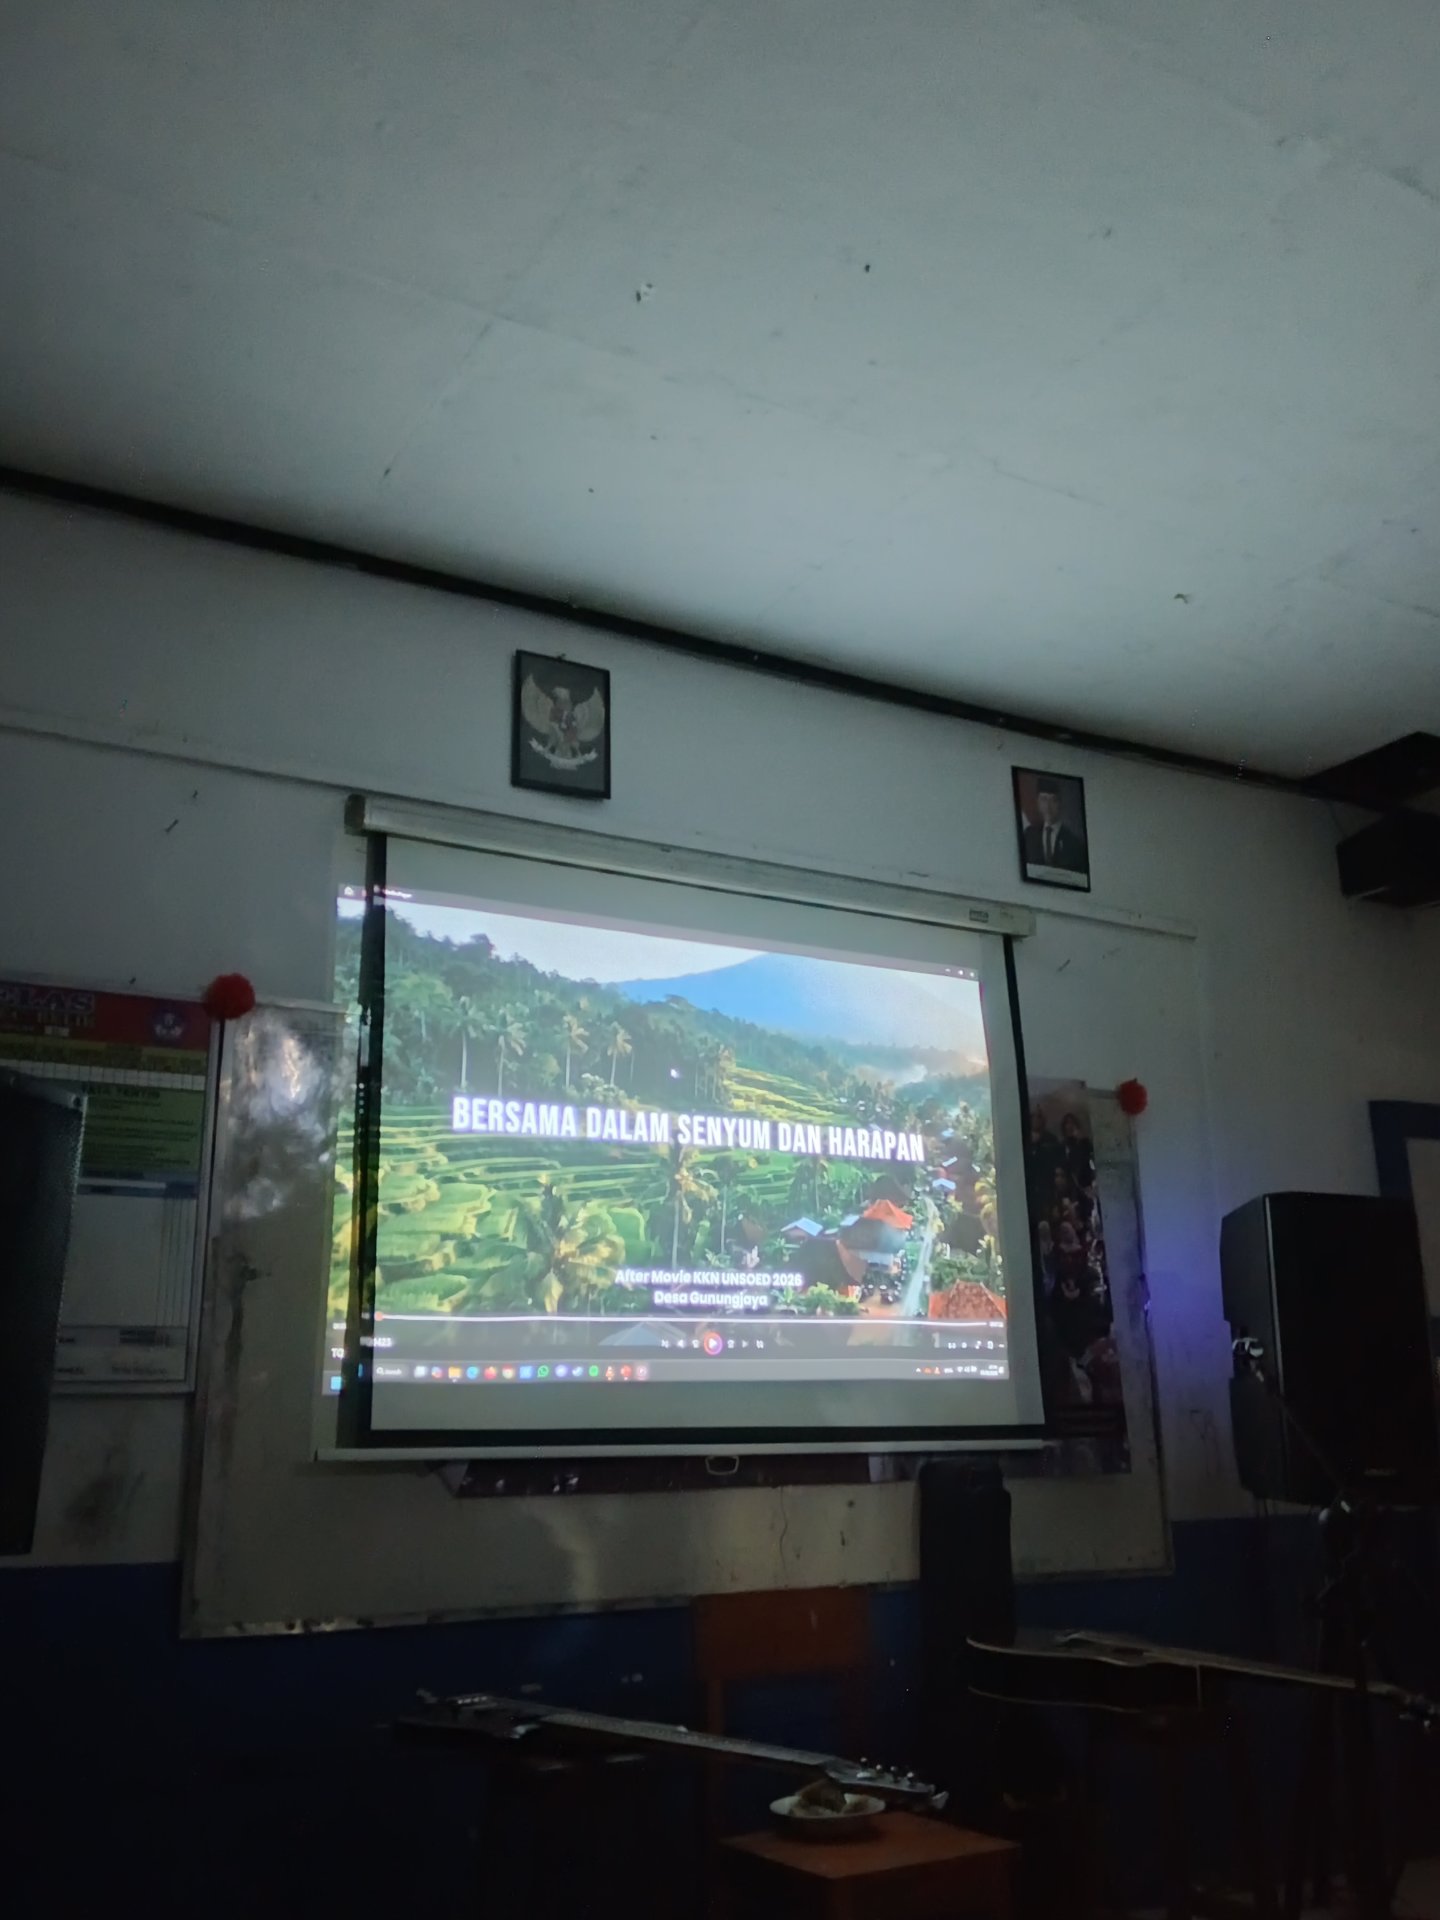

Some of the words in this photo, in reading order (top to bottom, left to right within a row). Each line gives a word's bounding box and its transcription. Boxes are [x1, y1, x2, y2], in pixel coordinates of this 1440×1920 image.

[452, 1096, 577, 1137] BERSAMA
[586, 1107, 670, 1144] DALAM
[677, 1113, 771, 1151] SENYUM
[778, 1121, 823, 1155] DAN
[828, 1125, 926, 1163] HARAPAN
[614, 1268, 650, 1285] After
[651, 1269, 692, 1285] Movie
[693, 1271, 720, 1286] KKN
[721, 1272, 772, 1287] UNSOED
[653, 1290, 688, 1305] Desa
[689, 1291, 769, 1310] Gunungjaya
